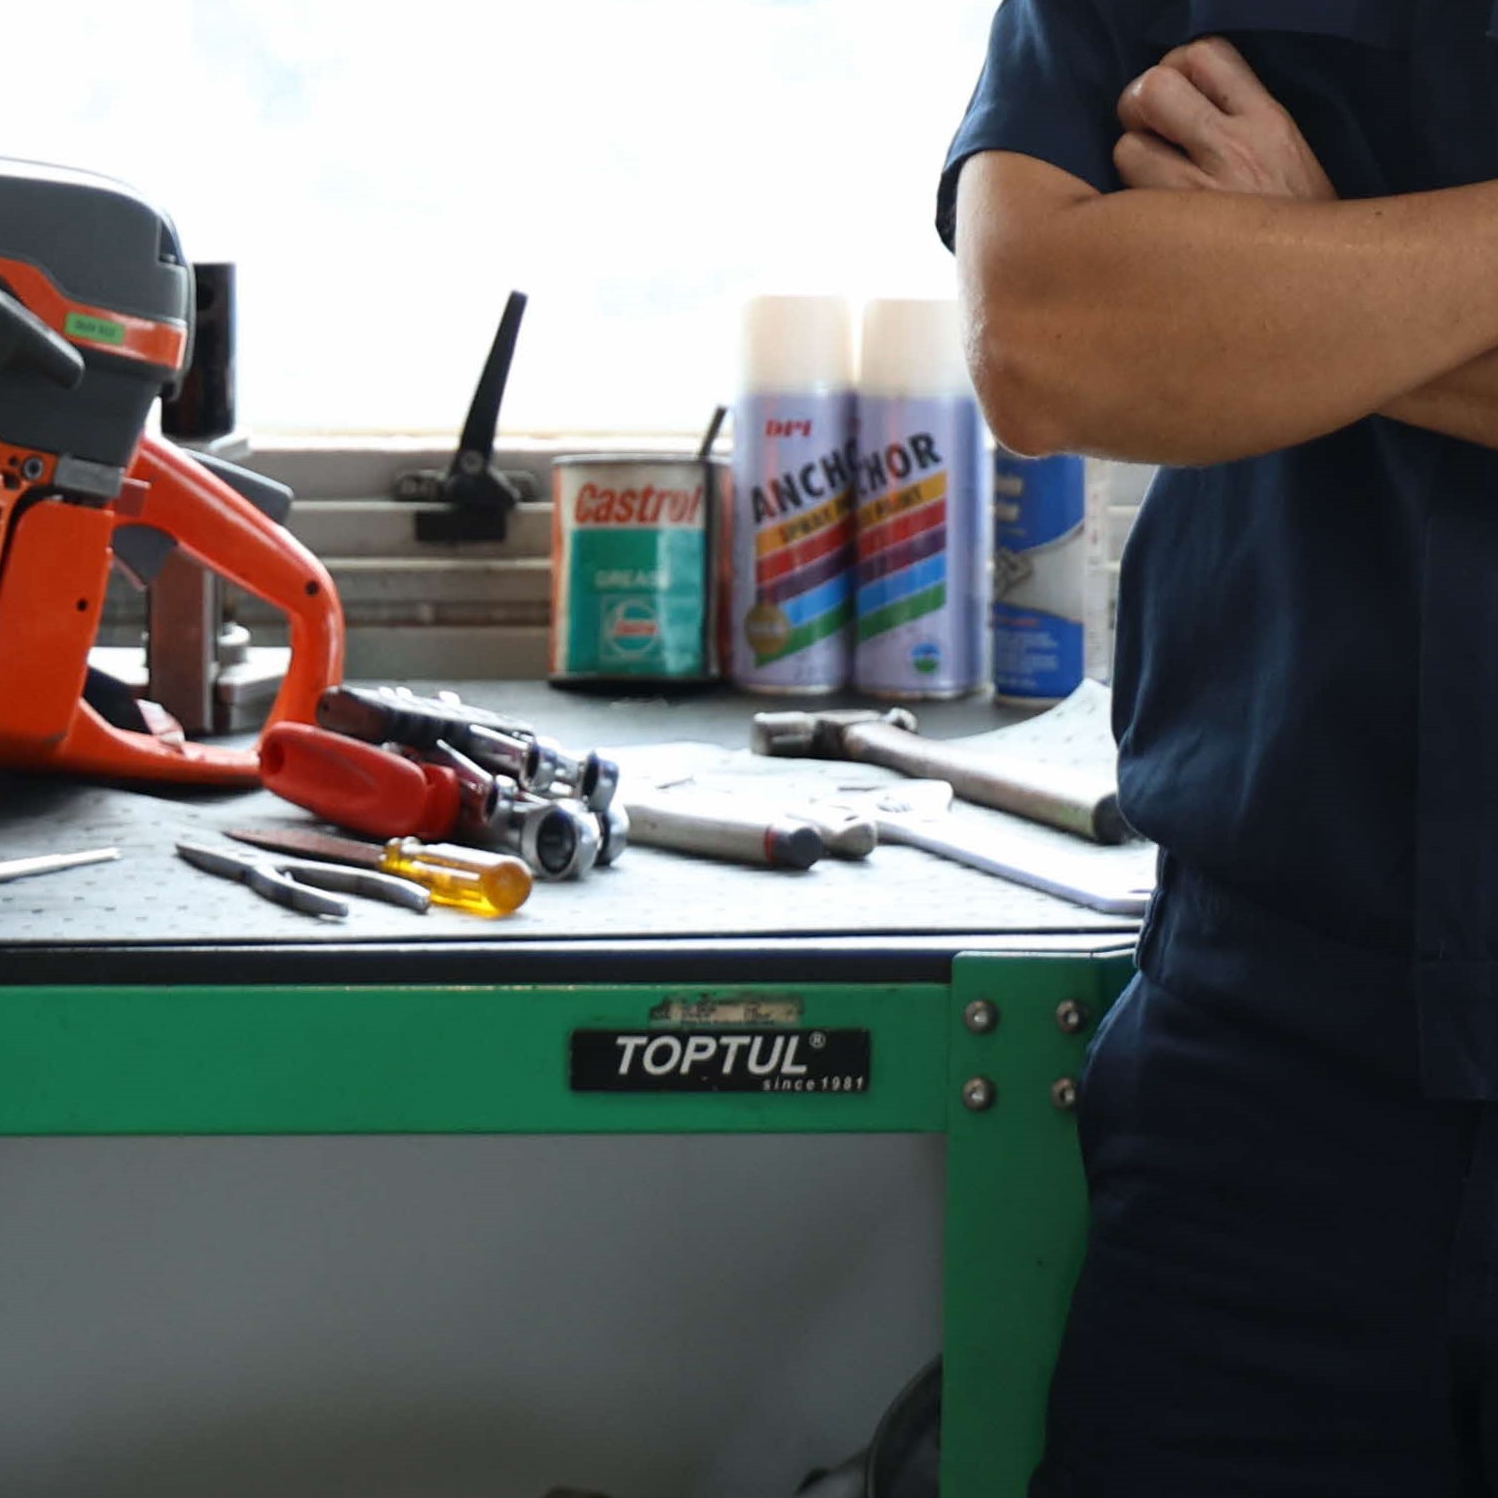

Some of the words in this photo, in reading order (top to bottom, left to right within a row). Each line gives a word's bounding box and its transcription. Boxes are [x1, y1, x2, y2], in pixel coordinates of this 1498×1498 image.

[575, 482, 703, 524] Castrol
[615, 1035, 808, 1075] TOPTUL
[763, 1076, 815, 1091] since
[820, 1076, 864, 1091] 1981
